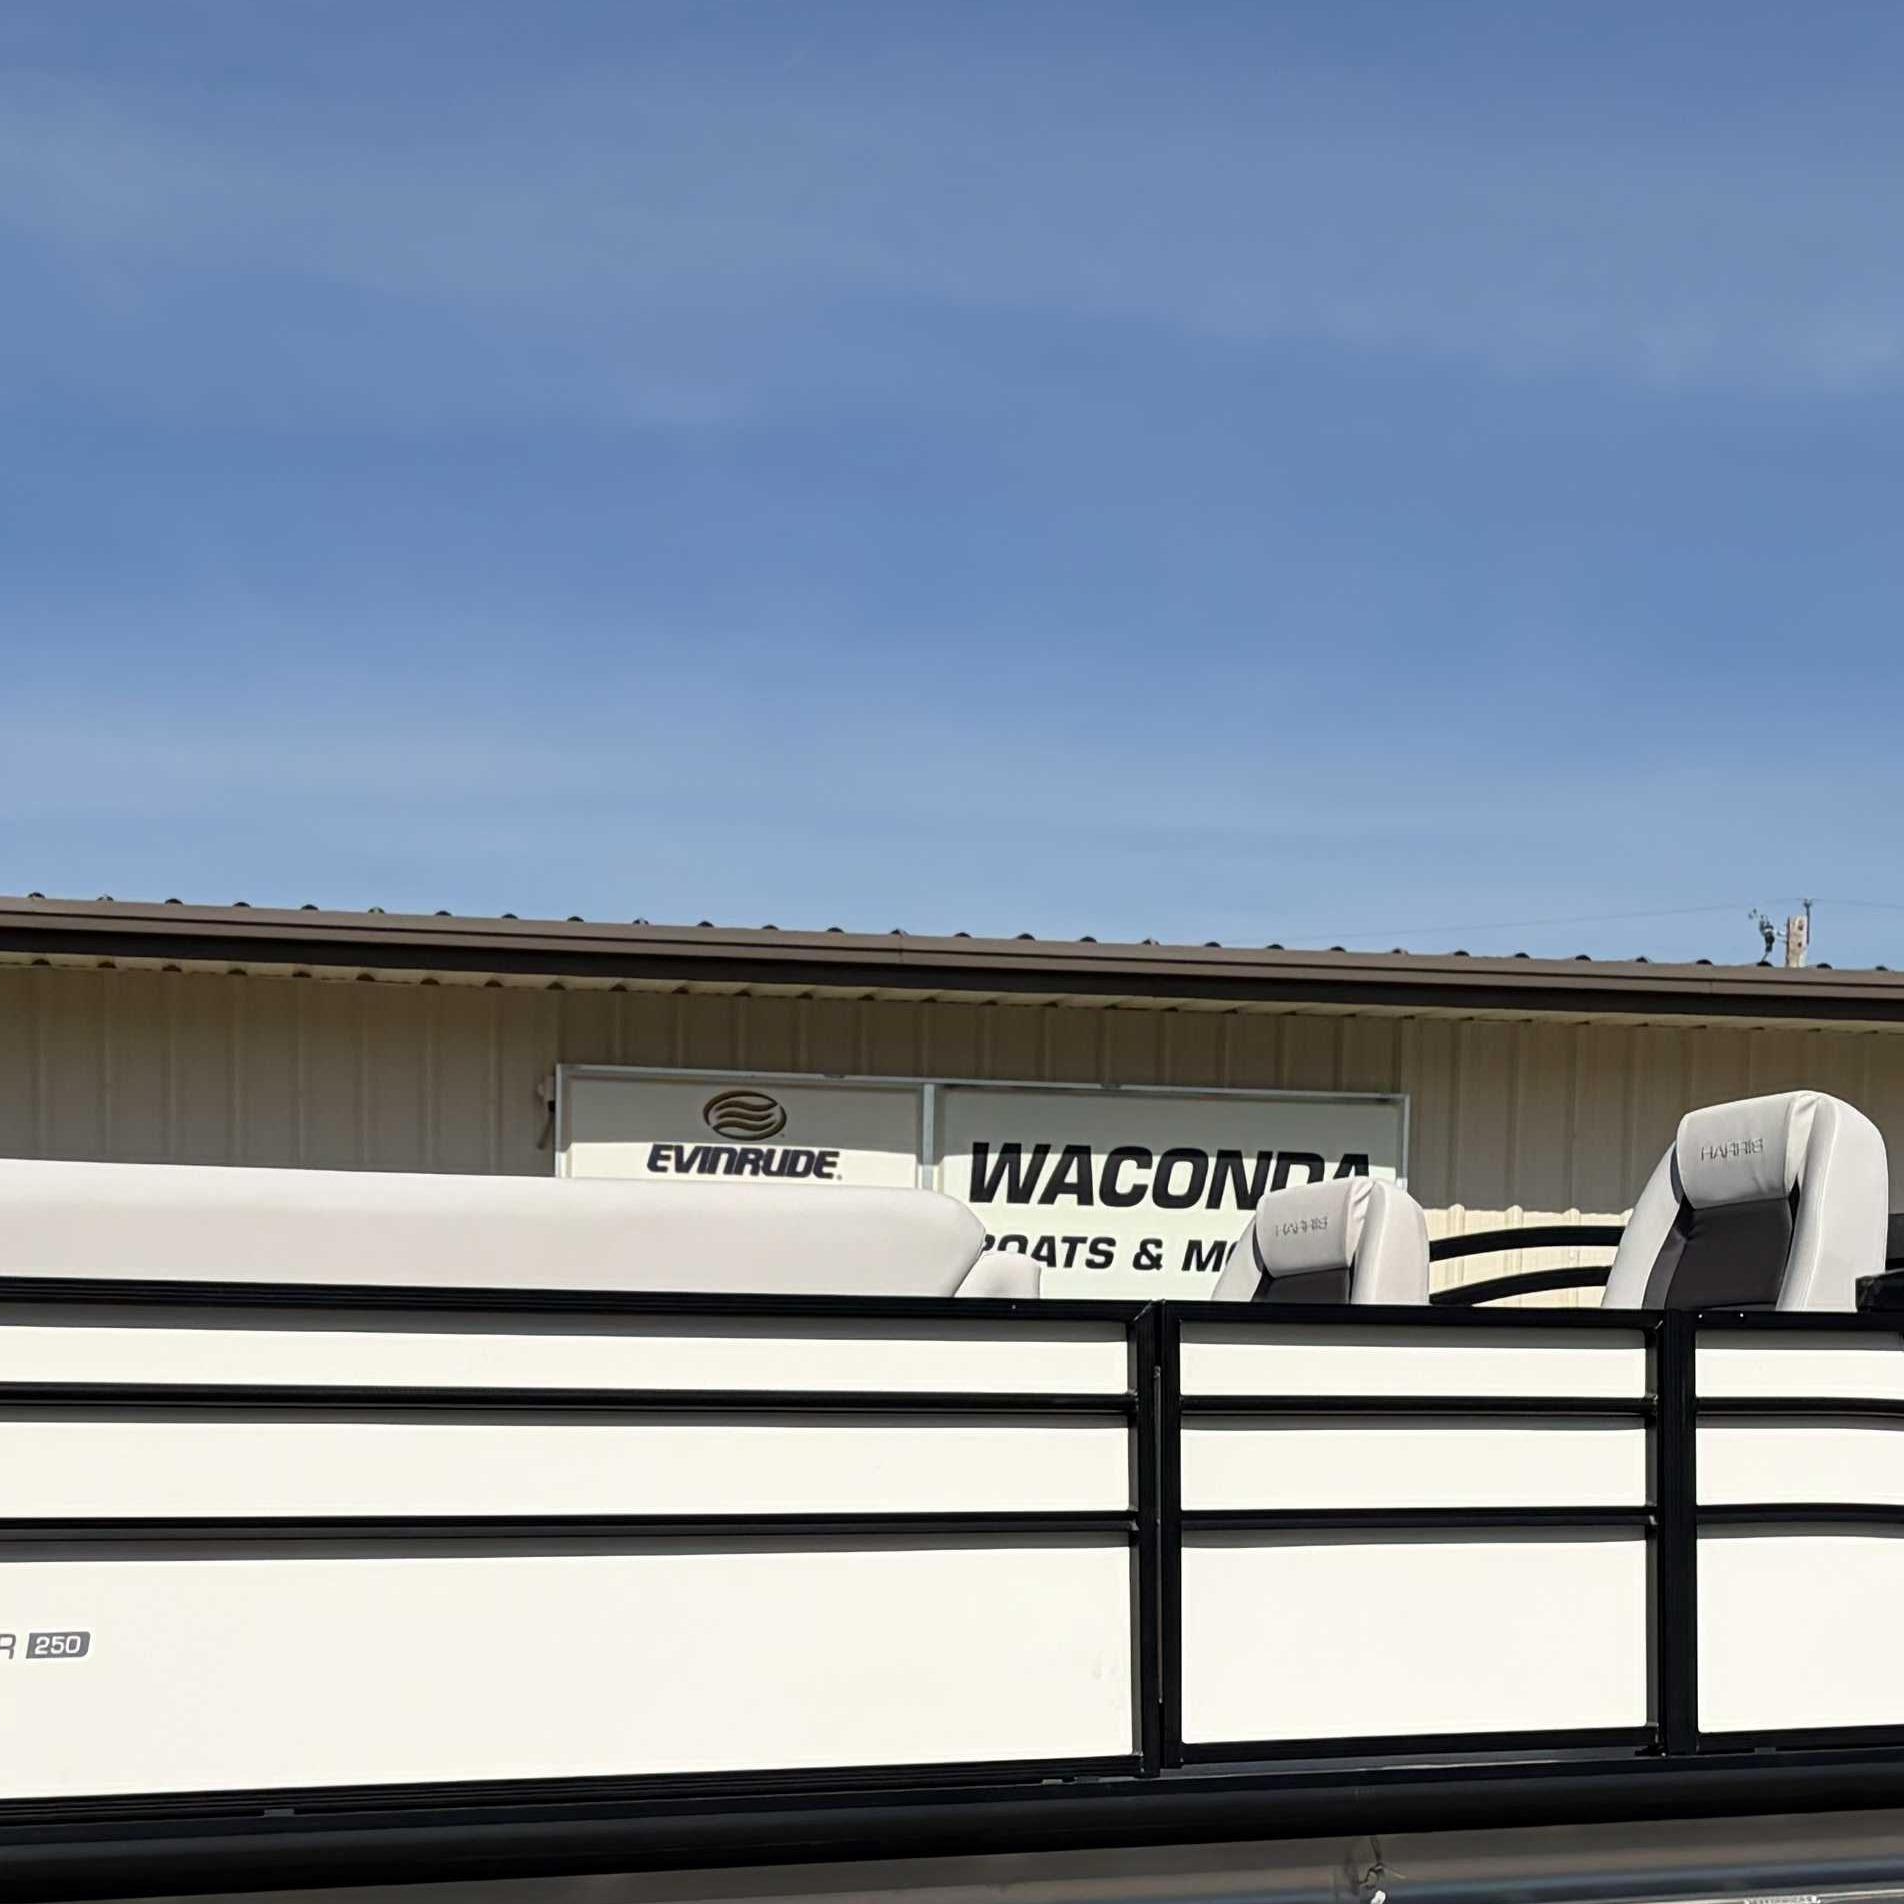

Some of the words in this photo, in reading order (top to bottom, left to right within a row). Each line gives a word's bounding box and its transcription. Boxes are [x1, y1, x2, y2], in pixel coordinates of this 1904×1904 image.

[646, 1143, 838, 1180] EVINRUDE
[1132, 1238, 1163, 1271] &
[34, 1635, 81, 1655] 250
